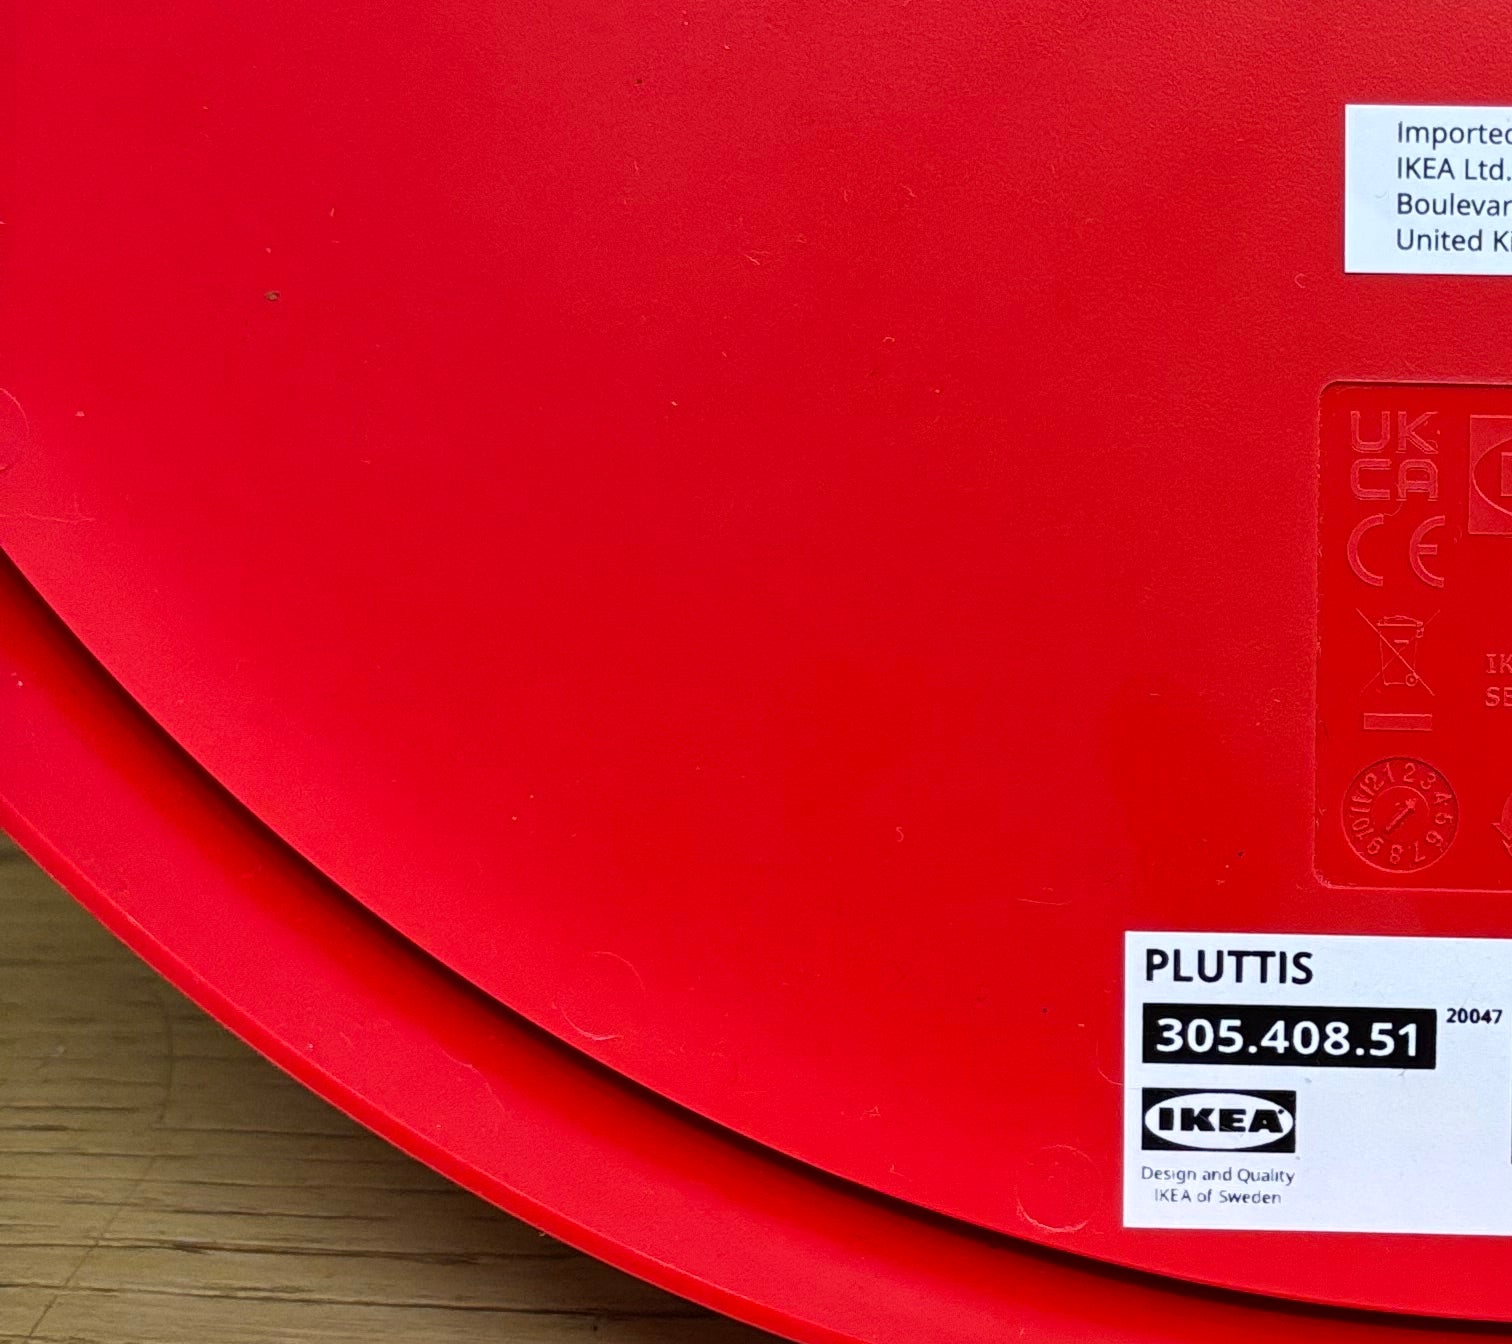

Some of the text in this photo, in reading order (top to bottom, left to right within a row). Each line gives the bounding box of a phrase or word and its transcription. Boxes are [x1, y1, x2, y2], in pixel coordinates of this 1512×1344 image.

[1397, 157, 1455, 180] IKEA
[1397, 229, 1482, 252] United
[1145, 948, 1314, 984] PLUTTIS
[1446, 1008, 1502, 1024] 20047
[1155, 1018, 1417, 1057] 305.408.51
[1159, 1108, 1284, 1133] IKEA
[1141, 1166, 1295, 1185] Design and Quality
[1154, 1188, 1281, 1204] IKEA of Sweden
